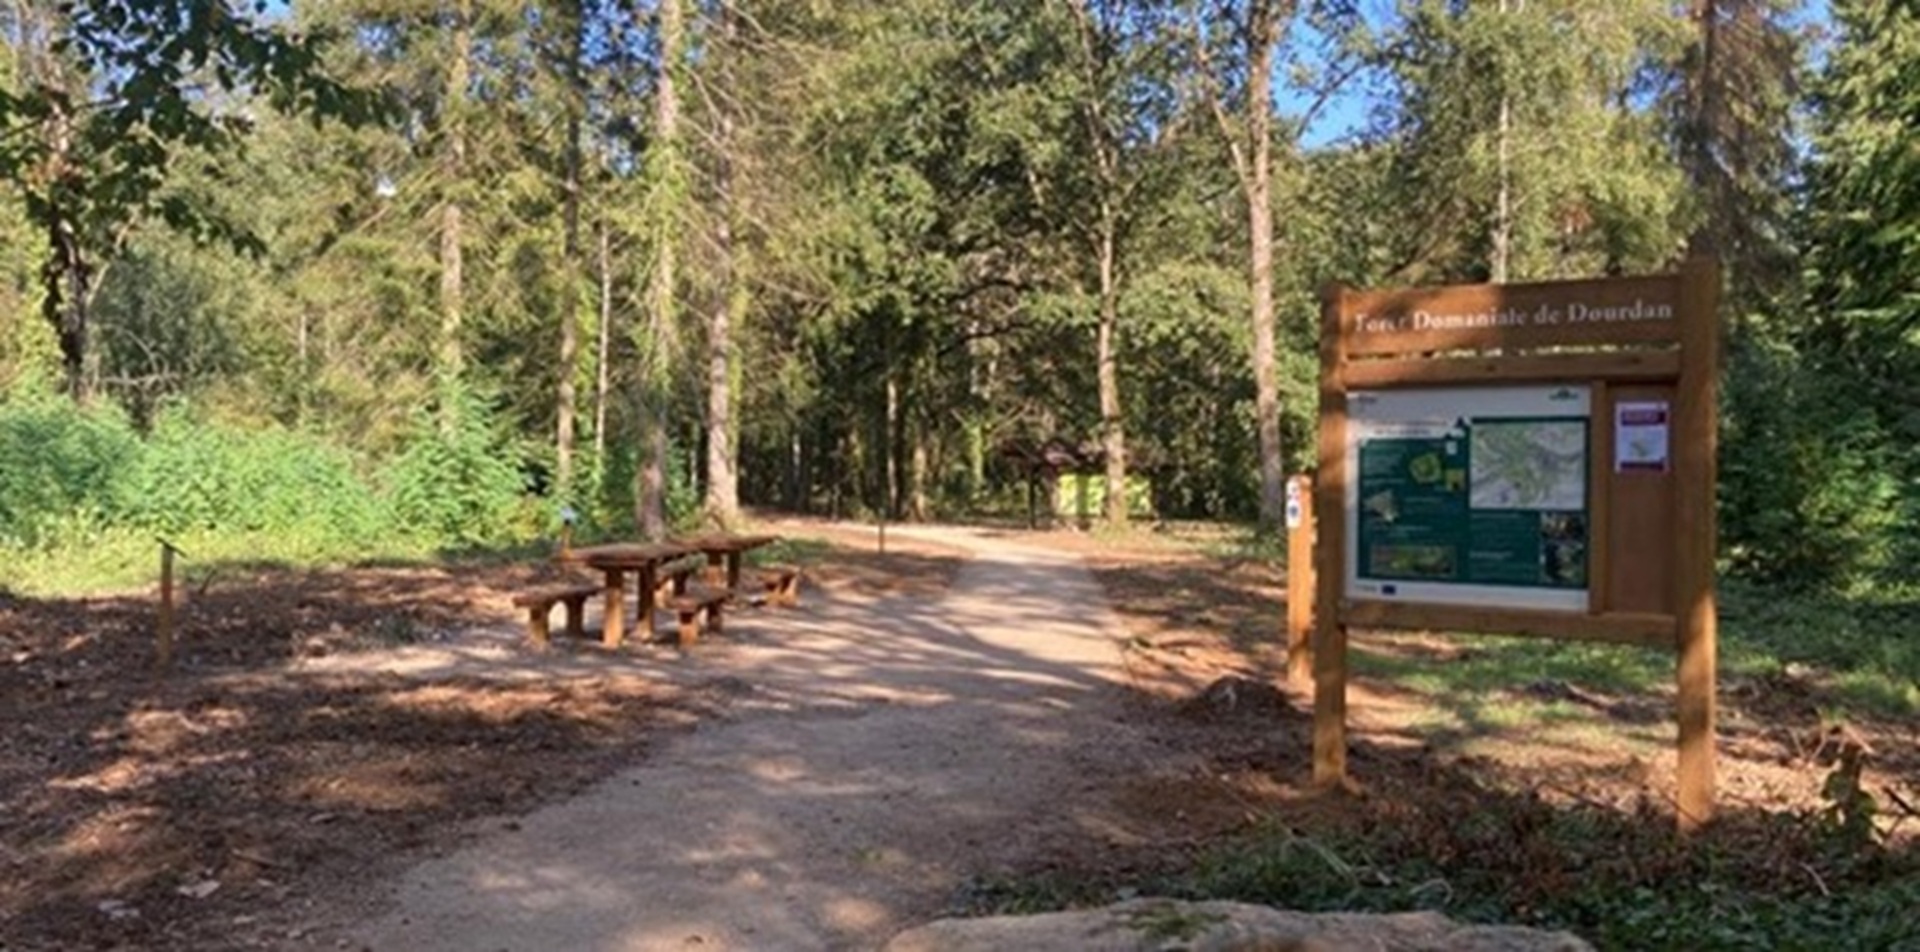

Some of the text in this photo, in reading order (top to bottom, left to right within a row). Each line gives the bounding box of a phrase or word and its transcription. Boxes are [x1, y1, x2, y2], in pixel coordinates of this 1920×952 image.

[1412, 307, 1526, 331] Domaniale
[1533, 303, 1561, 325] de
[1567, 298, 1674, 322] Dourdan
